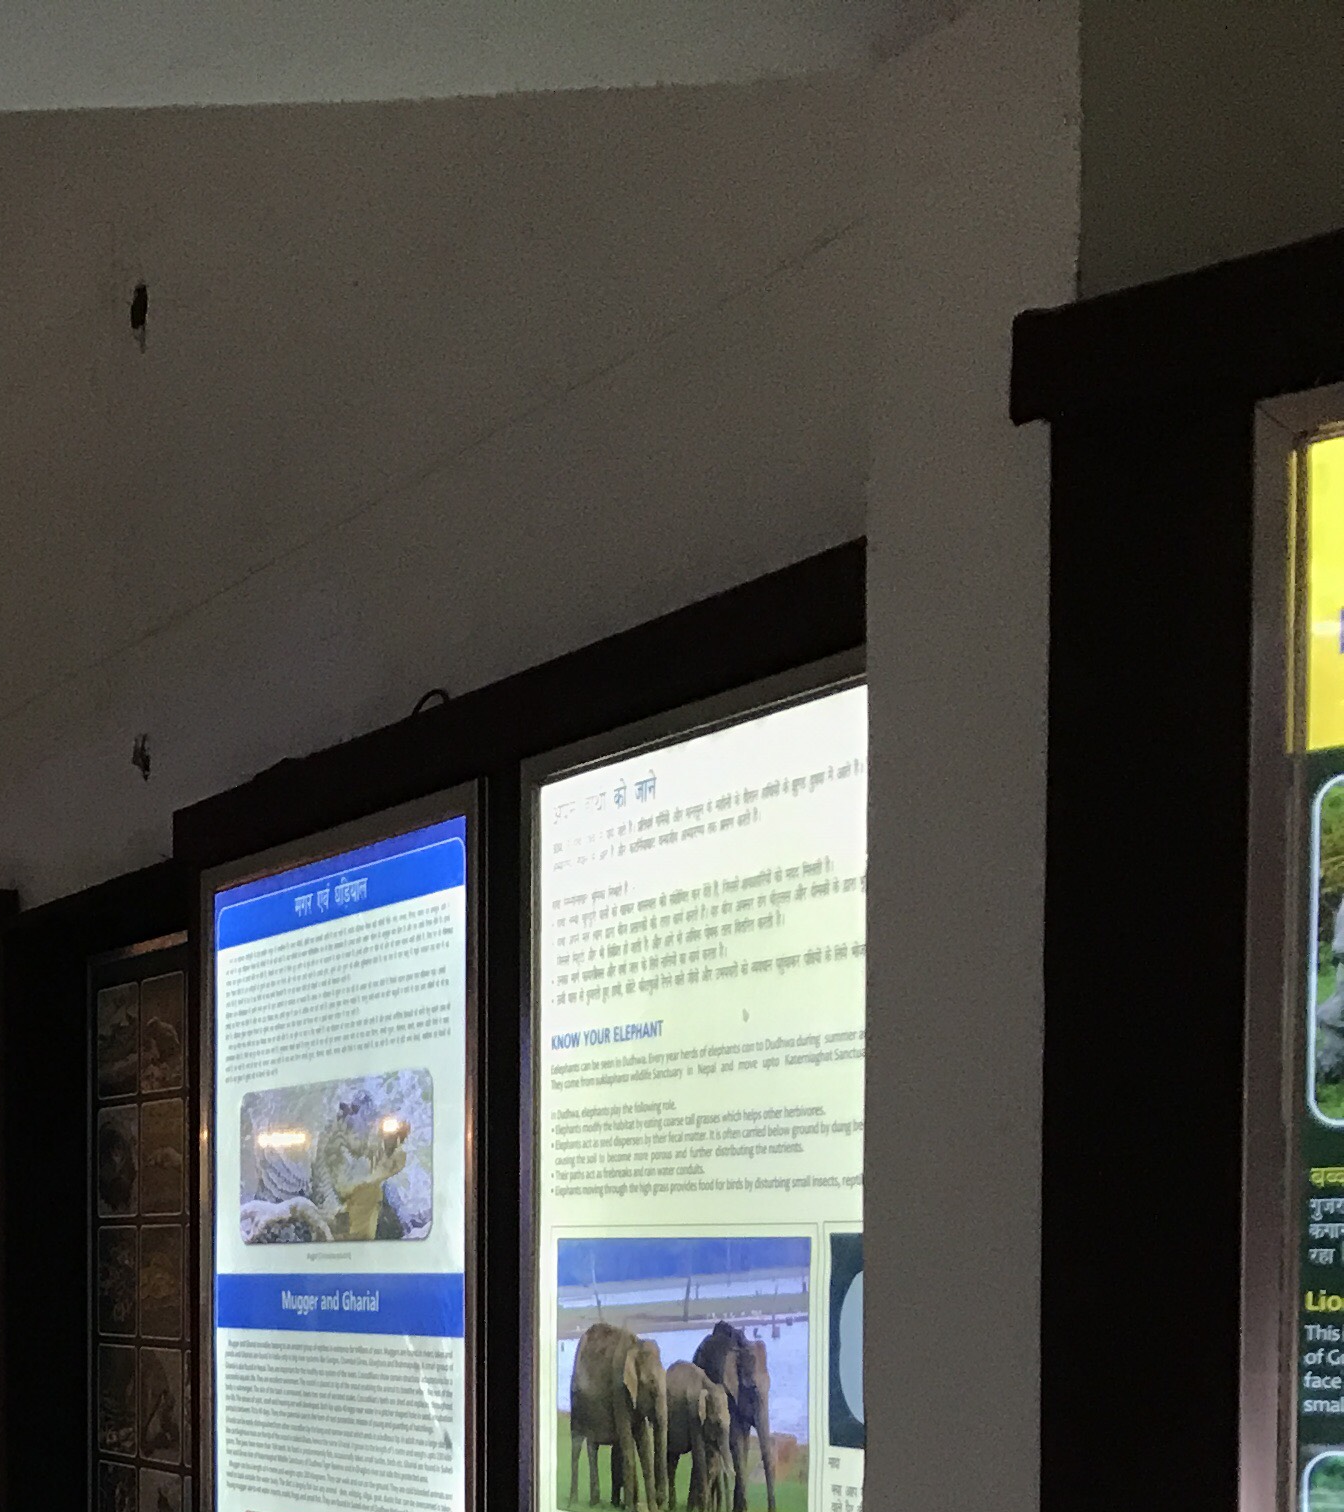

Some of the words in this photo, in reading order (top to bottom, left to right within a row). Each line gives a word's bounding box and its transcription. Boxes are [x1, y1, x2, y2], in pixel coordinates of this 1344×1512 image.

[551, 1031, 580, 1050] KNOW
[583, 1026, 611, 1047] YOUR
[613, 1020, 664, 1043] ELEPHANT
[281, 1289, 319, 1315] Mugger
[321, 1289, 340, 1311] and
[342, 1289, 379, 1312] Gharial
[1305, 1289, 1344, 1312] Lio
[1305, 1324, 1340, 1342] This
[1304, 1348, 1324, 1366] of
[1304, 1371, 1341, 1390] face
